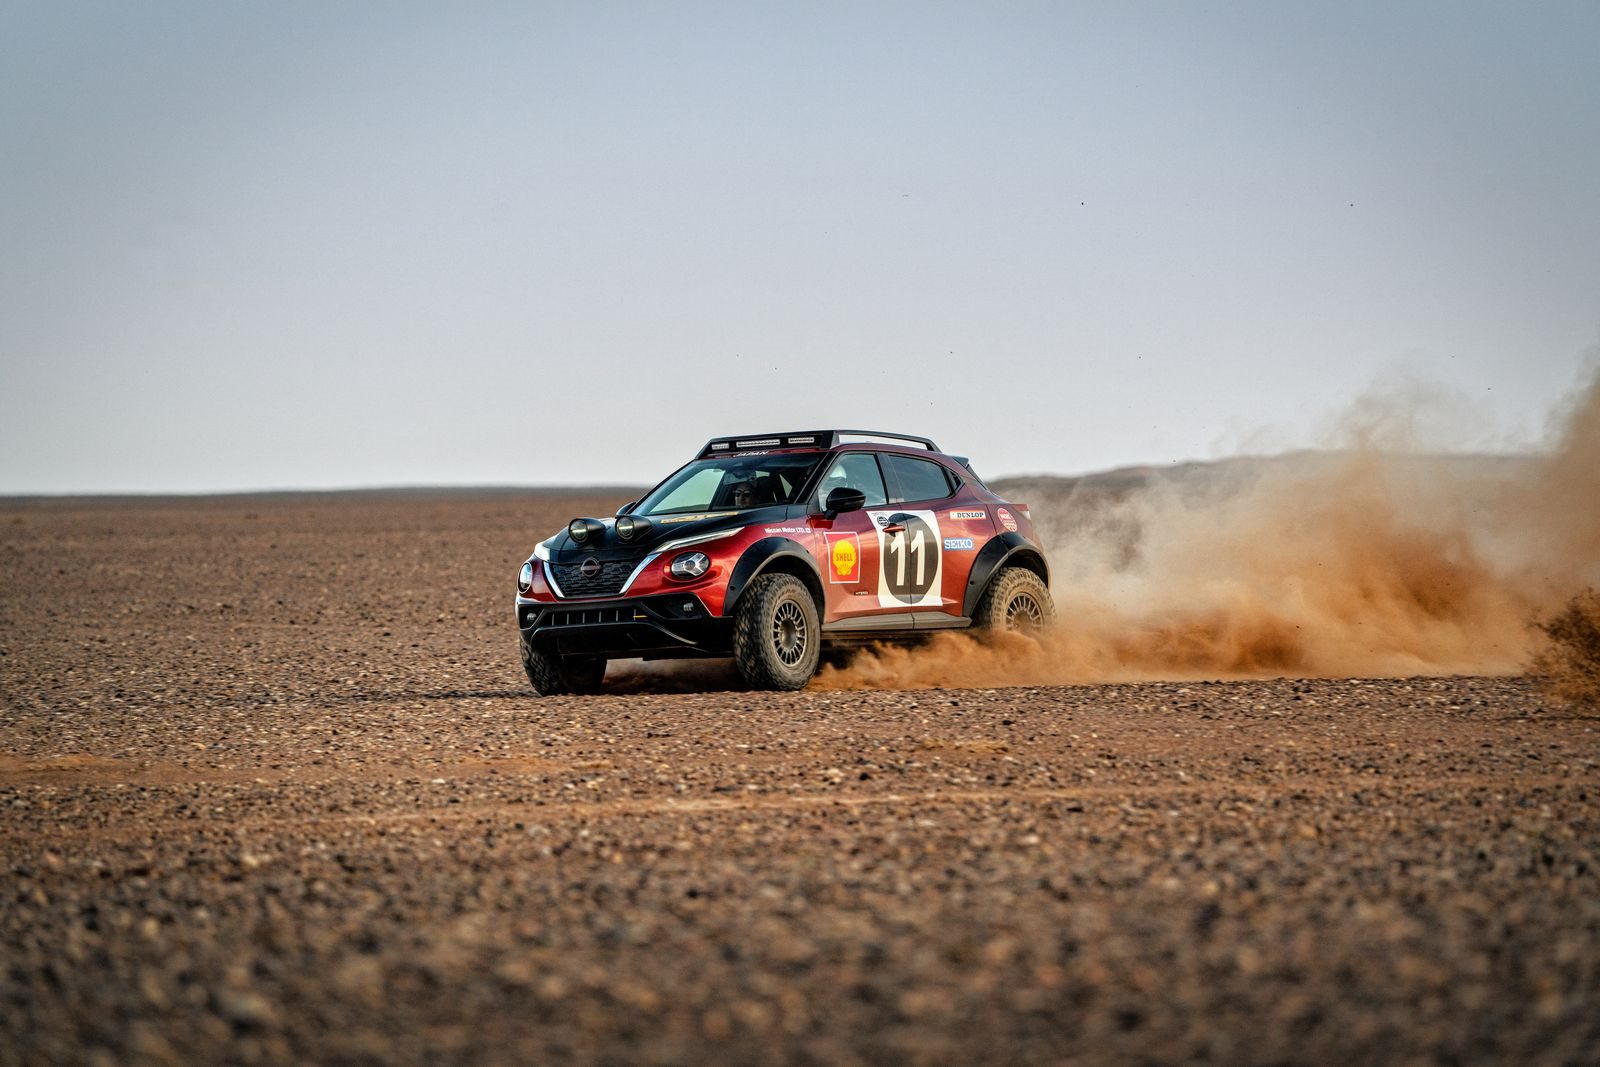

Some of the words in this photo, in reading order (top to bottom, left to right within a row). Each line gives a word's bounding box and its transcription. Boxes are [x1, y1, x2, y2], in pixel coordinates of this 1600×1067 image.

[944, 539, 973, 549] SEIKO
[835, 552, 853, 562] SHELL
[891, 530, 925, 586] 11
